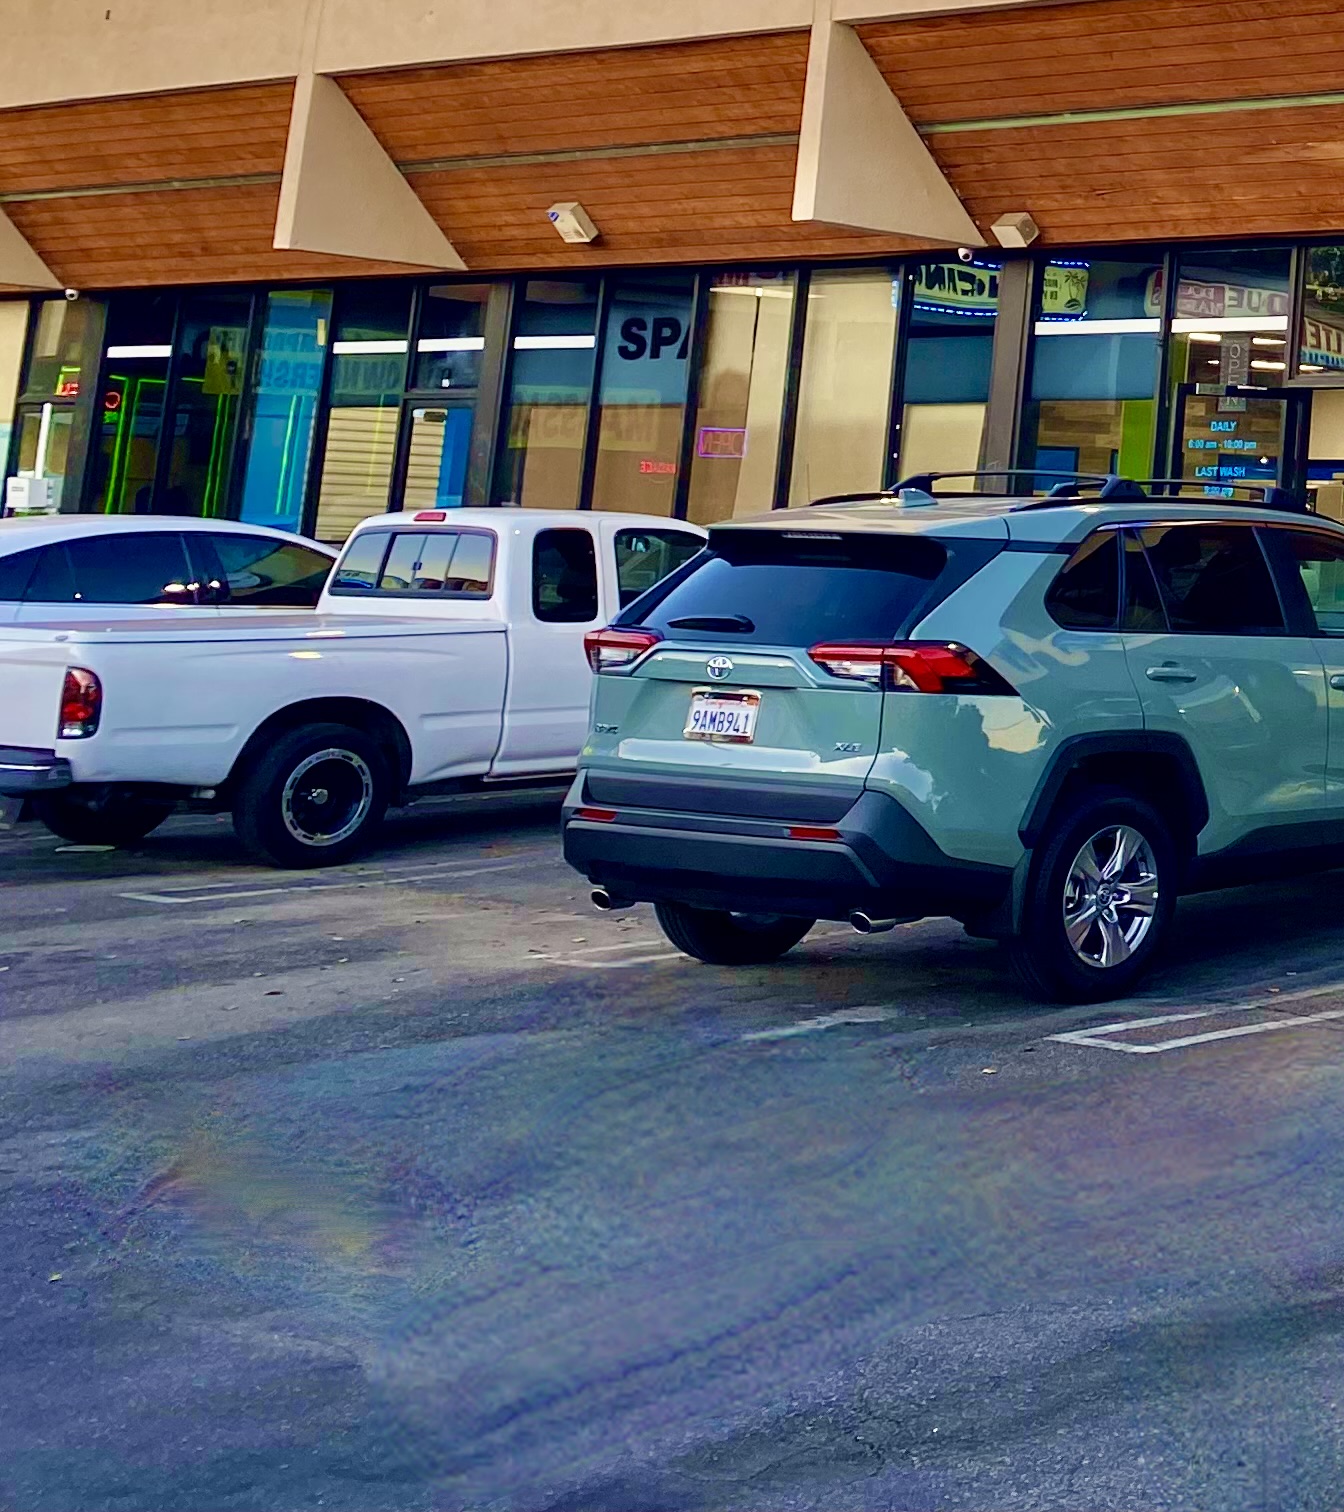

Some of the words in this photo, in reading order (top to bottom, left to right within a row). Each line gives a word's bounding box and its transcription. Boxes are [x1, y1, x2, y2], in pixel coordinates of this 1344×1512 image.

[1210, 421, 1237, 431] DAILY
[1195, 466, 1218, 477] LAST
[1219, 466, 1246, 477] WASH
[691, 710, 751, 735] 9AMB941
